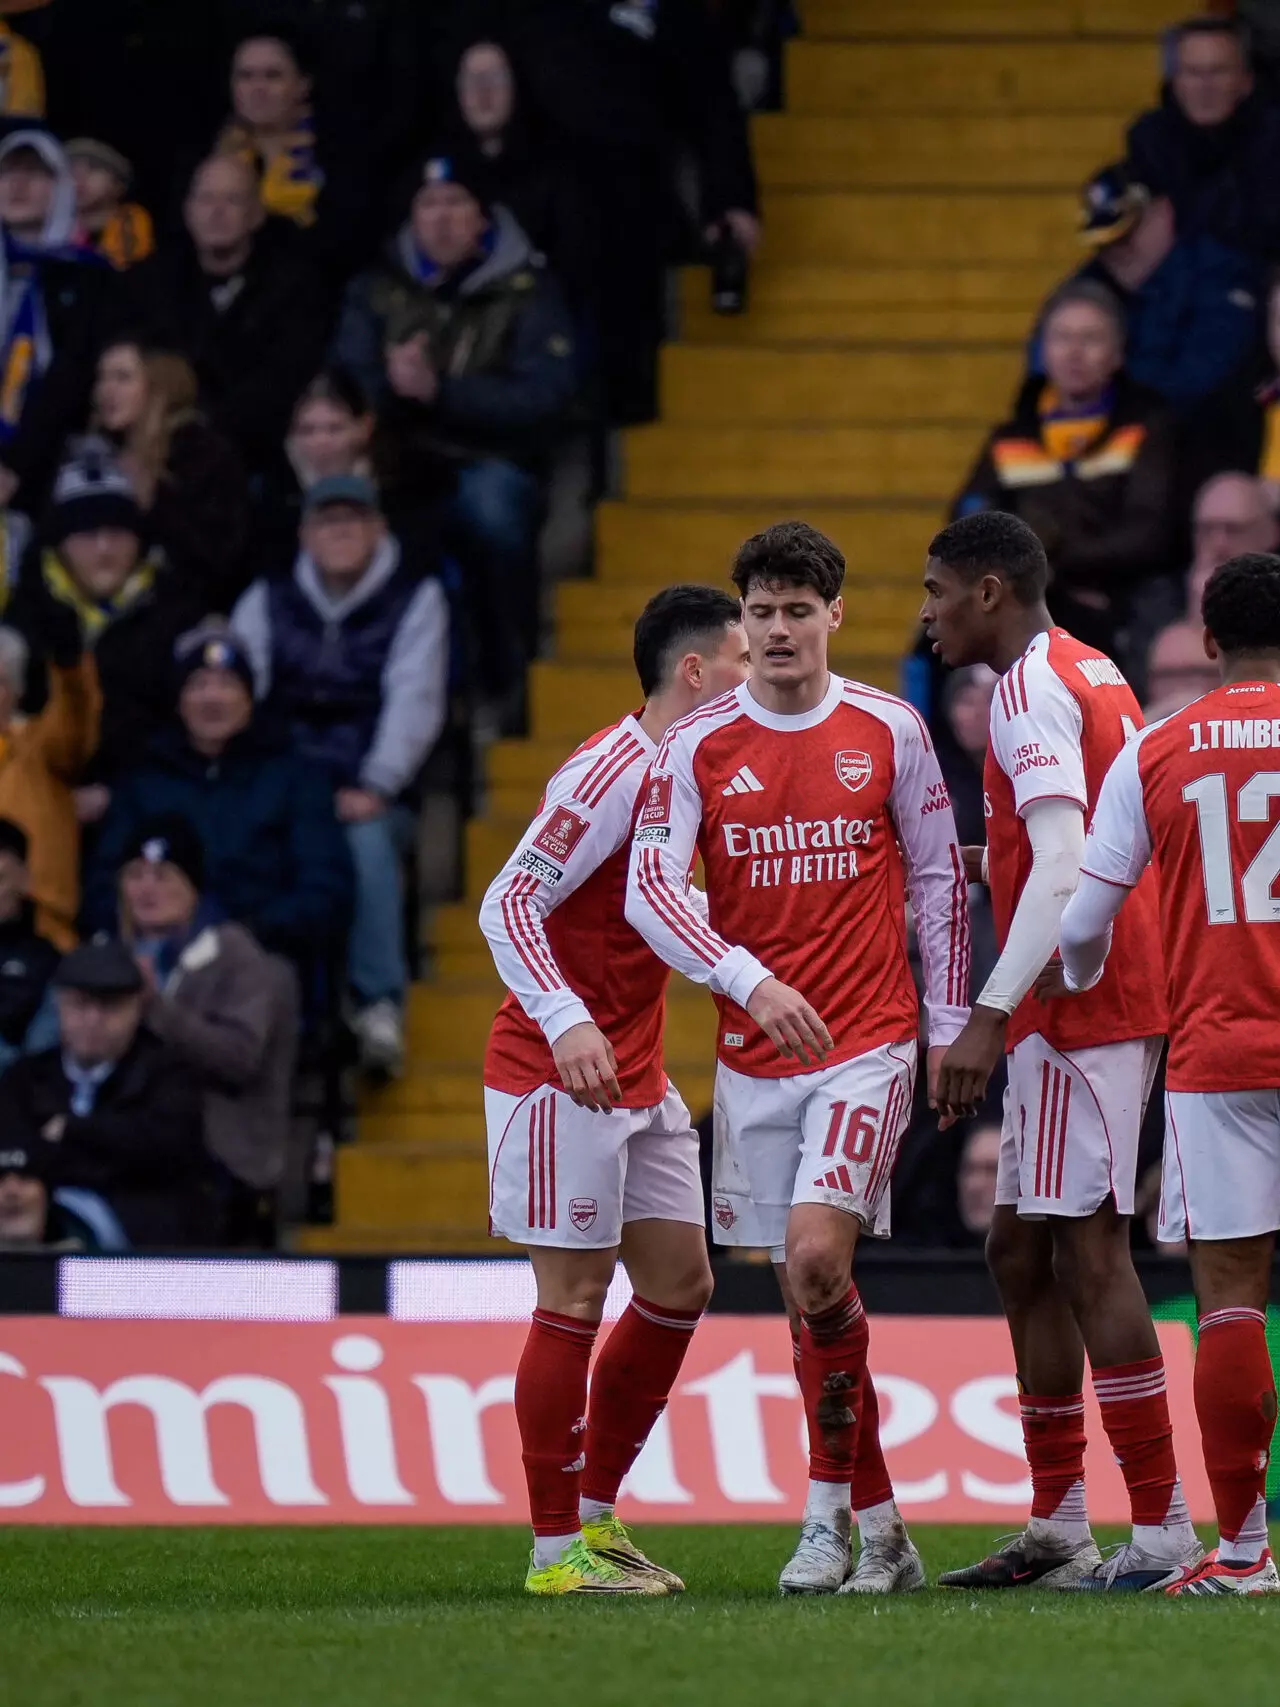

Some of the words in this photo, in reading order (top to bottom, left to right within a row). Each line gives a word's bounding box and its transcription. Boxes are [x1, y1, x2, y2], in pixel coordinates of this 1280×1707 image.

[1226, 685, 1265, 694] Arsenal
[840, 756, 867, 765] Arsenal
[650, 811, 665, 820] CUP
[544, 831, 568, 851] Emirates
[644, 827, 667, 836] room
[722, 814, 873, 857] Emirates
[539, 837, 550, 847] FA
[550, 843, 566, 856] CUP
[520, 849, 536, 863] No
[534, 857, 559, 879] room
[751, 857, 784, 888] FLY
[790, 850, 859, 884] BETTER
[529, 864, 558, 888] racism
[821, 1099, 881, 1165] 16
